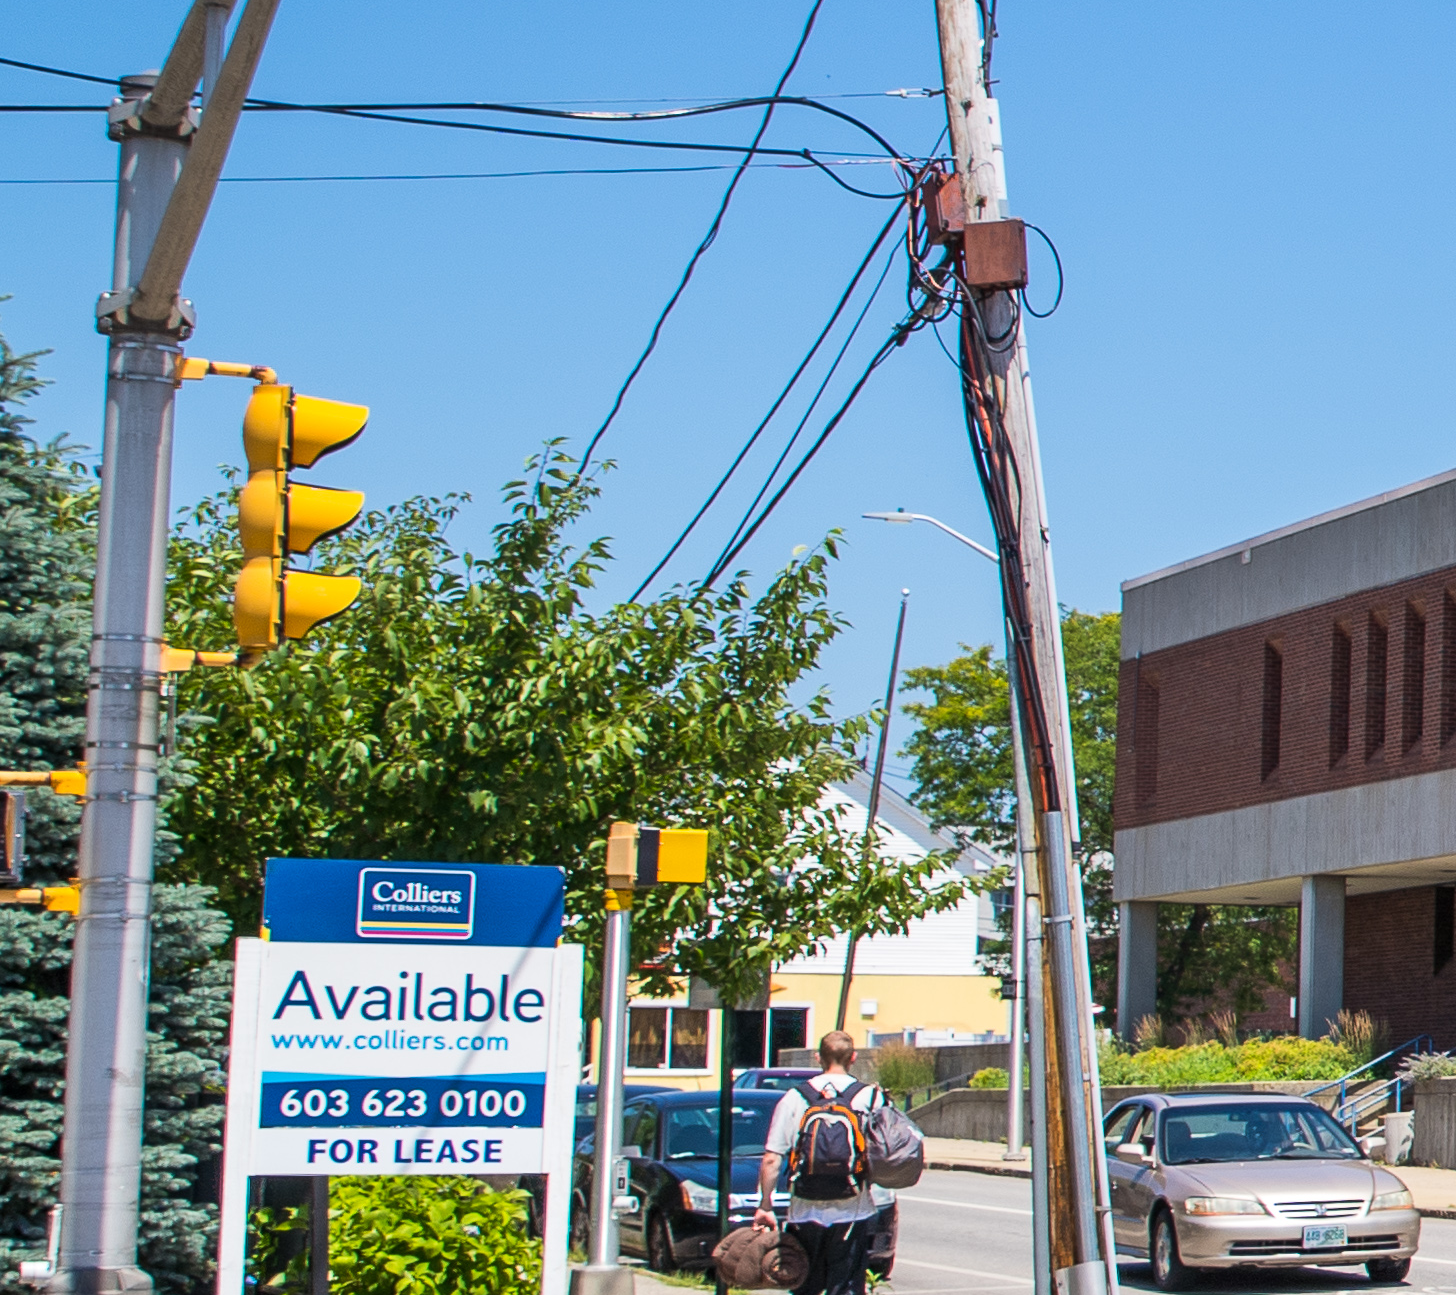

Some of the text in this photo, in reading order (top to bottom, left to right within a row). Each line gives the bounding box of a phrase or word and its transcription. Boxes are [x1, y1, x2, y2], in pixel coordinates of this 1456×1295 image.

[371, 881, 462, 904] Colliers
[371, 903, 461, 914] INTERNATIONAL
[272, 970, 545, 1023] Available
[271, 1030, 509, 1051] www.colliers.com
[279, 1089, 526, 1117] 603 623 0100
[307, 1139, 503, 1164] FOR LEASE
